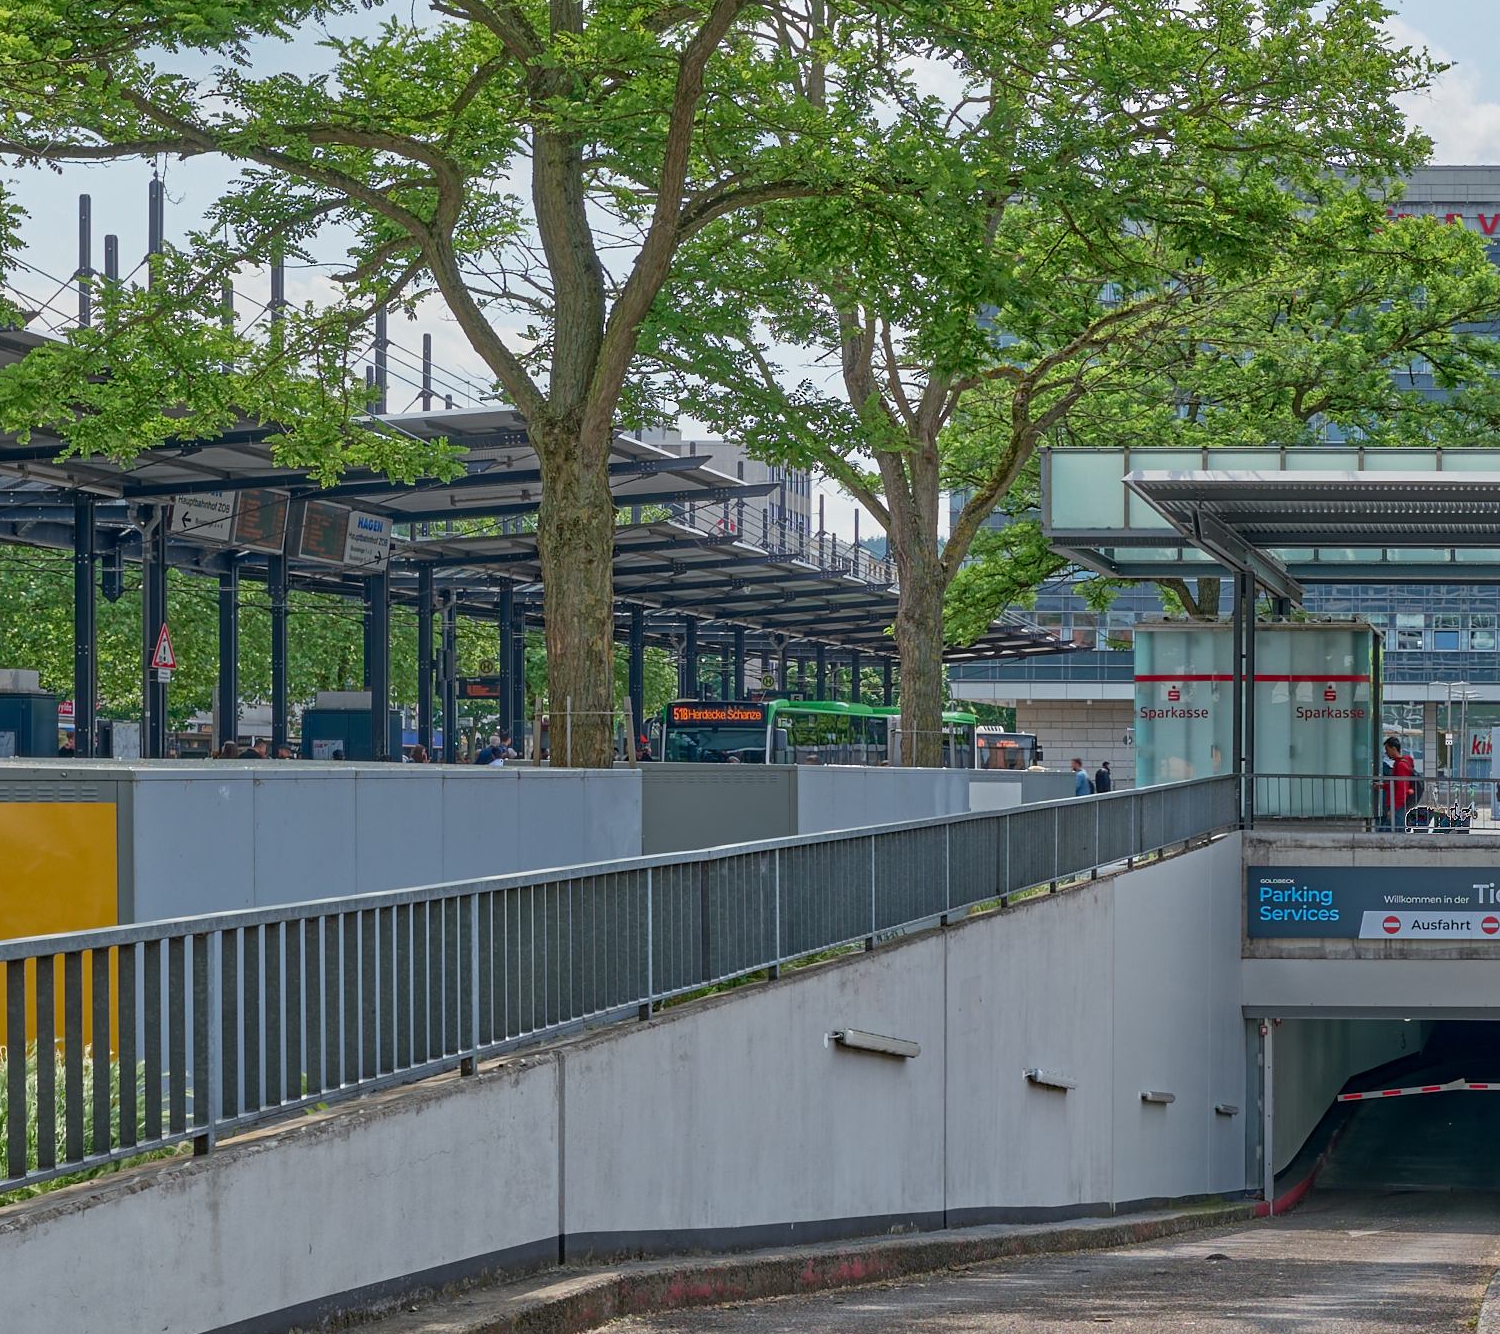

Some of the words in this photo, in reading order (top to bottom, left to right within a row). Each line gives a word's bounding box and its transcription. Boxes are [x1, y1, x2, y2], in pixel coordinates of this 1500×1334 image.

[357, 517, 384, 533] HAGEN
[673, 707, 688, 720] 518
[688, 708, 726, 720] Herdecke
[727, 708, 762, 720] Schanze
[1140, 706, 1209, 720] Sparkasse
[1296, 706, 1365, 720] Sparkasse
[1259, 886, 1333, 905] Parking
[1383, 895, 1442, 904] Willkommen
[1443, 895, 1452, 904] in
[1454, 895, 1470, 904] der
[1259, 905, 1340, 921] Services
[1411, 918, 1472, 931] Ausfahrt
